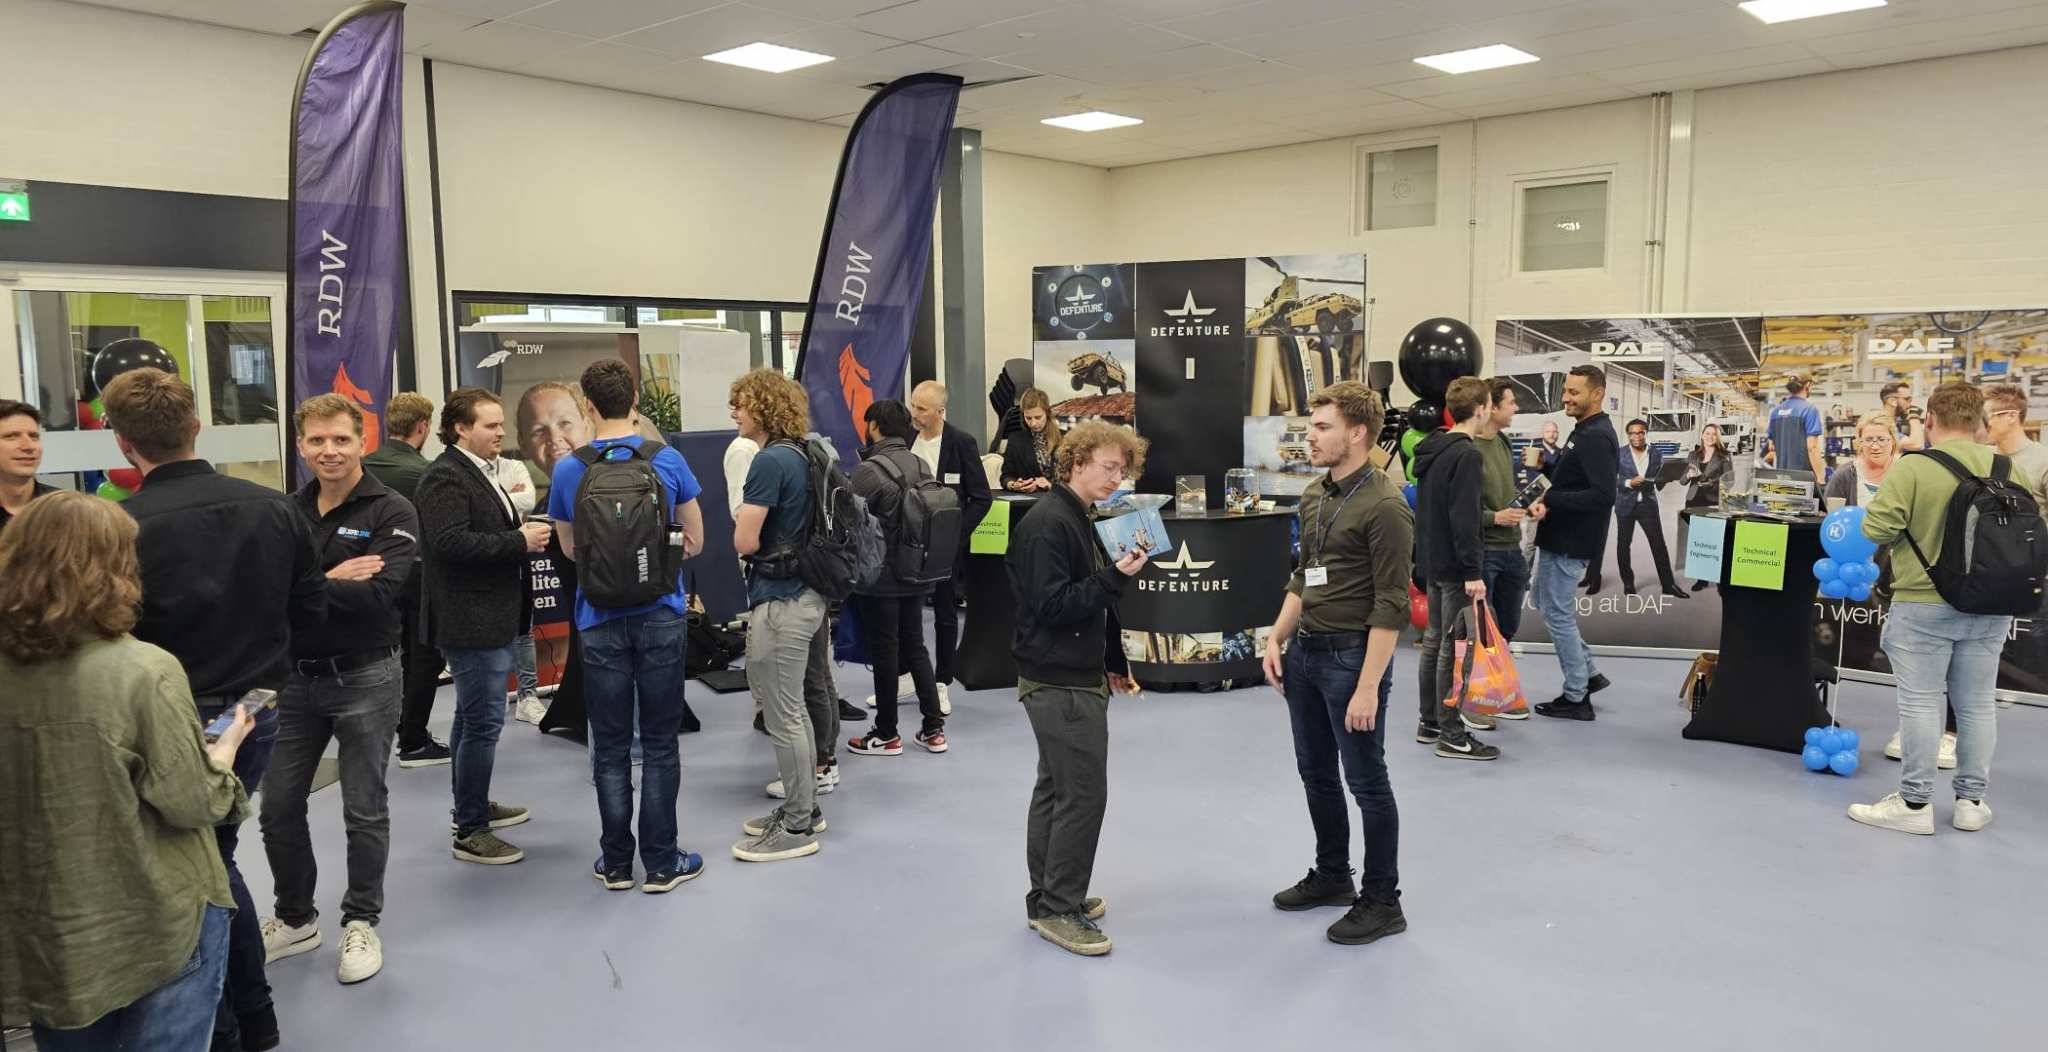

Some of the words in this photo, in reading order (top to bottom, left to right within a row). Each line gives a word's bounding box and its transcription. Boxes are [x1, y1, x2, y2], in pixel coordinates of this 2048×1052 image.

[318, 229, 347, 338] RDW
[835, 241, 873, 326] RDW
[1060, 303, 1104, 316] DEFENTURE
[1151, 325, 1230, 337] DEFENTURE
[517, 344, 544, 355] RDW
[1591, 342, 1665, 355] DAF
[1868, 338, 1955, 354] DAF
[1743, 547, 1777, 557] Technical
[637, 547, 649, 584] THULE
[1737, 556, 1781, 568] Commercial
[1138, 579, 1230, 592] DEFENTURE
[1599, 594, 1619, 613] at
[1626, 594, 1675, 615] DAF
